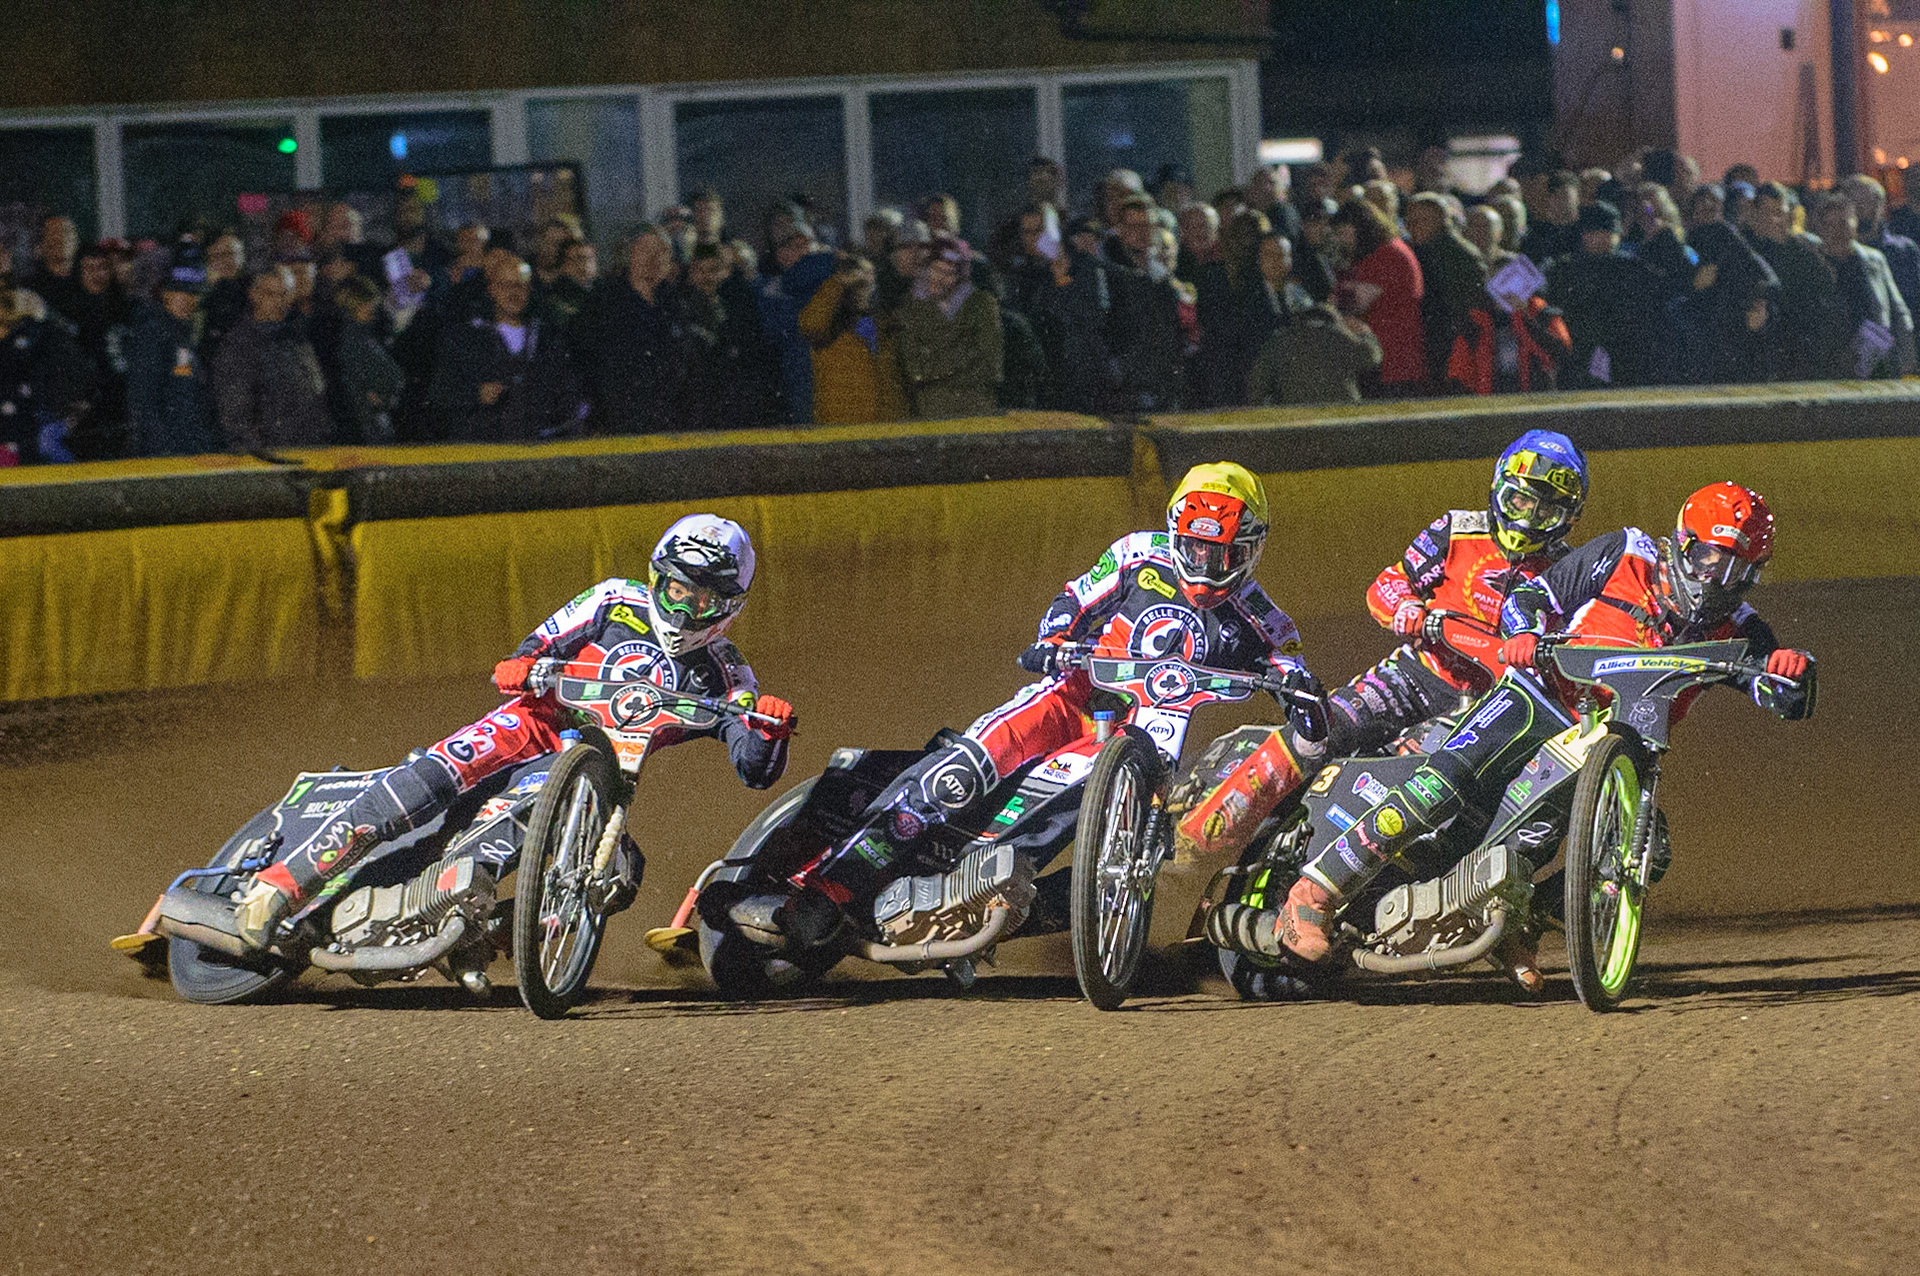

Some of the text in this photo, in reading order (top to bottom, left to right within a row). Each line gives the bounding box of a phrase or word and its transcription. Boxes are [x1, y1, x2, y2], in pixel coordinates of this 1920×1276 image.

[1142, 608, 1204, 660] BELLE VUE ACES
[617, 644, 649, 657] BELLE
[663, 670, 673, 691] ACE
[1597, 659, 1636, 671] Allied
[1311, 765, 1342, 792] 3
[287, 781, 314, 805] 1
